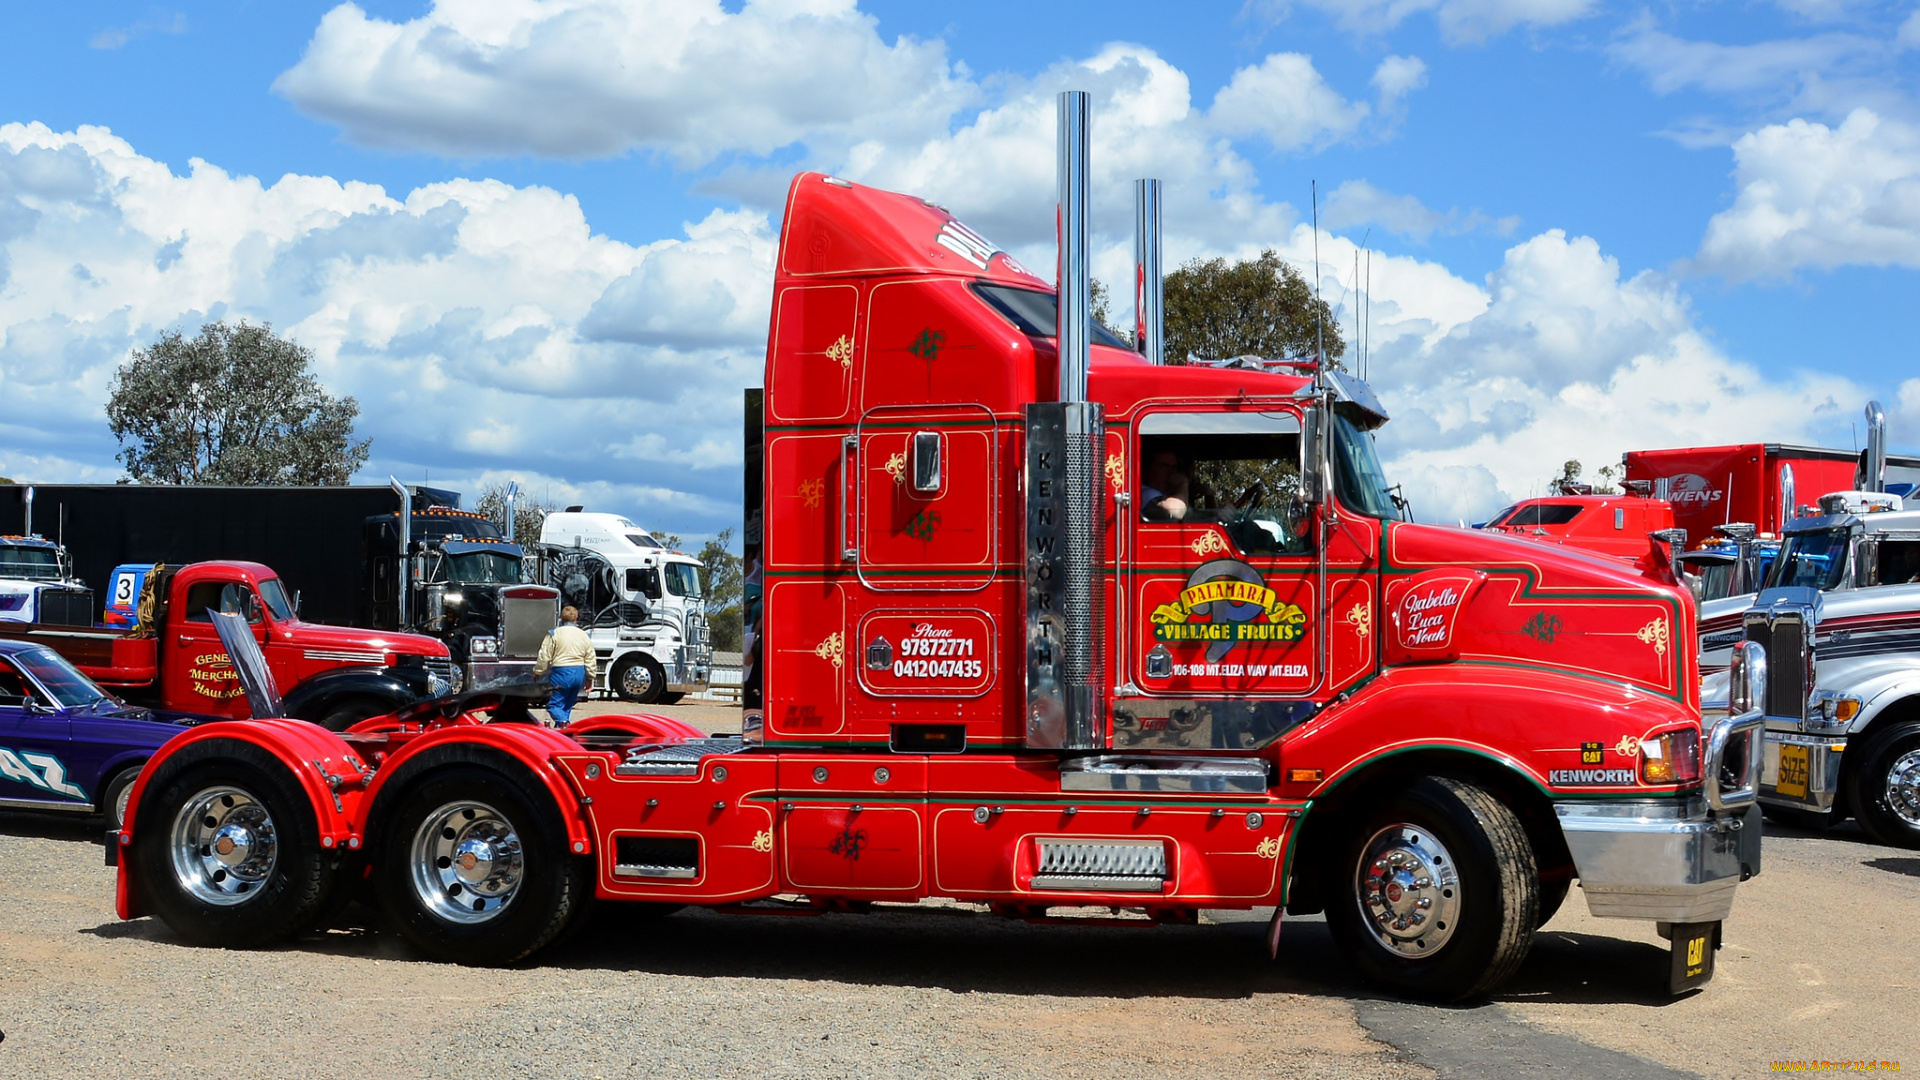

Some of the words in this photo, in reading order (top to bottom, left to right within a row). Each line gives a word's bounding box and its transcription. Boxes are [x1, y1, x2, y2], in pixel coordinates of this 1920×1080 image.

[1650, 489, 1723, 502] WENS
[1036, 453, 1055, 666] KENWORTH
[118, 578, 131, 600] 3
[1186, 582, 1267, 605] PALAMARA
[911, 622, 954, 638] Phone
[1407, 611, 1444, 631] Luca
[1164, 624, 1230, 640] VILLAGE
[1237, 624, 1294, 640] FRUITS
[1407, 625, 1447, 646] Noah
[901, 638, 974, 657] 97872771
[195, 653, 232, 665] GENE
[190, 668, 240, 683] MERCHA
[1173, 664, 1204, 677] 106-108
[1247, 664, 1268, 677] WAY
[194, 681, 247, 699] HAULAGE
[1583, 751, 1602, 763] CAT
[1549, 769, 1635, 783] KENWORTH
[1780, 755, 1806, 786] SIZE
[1687, 937, 1705, 967] CAT
